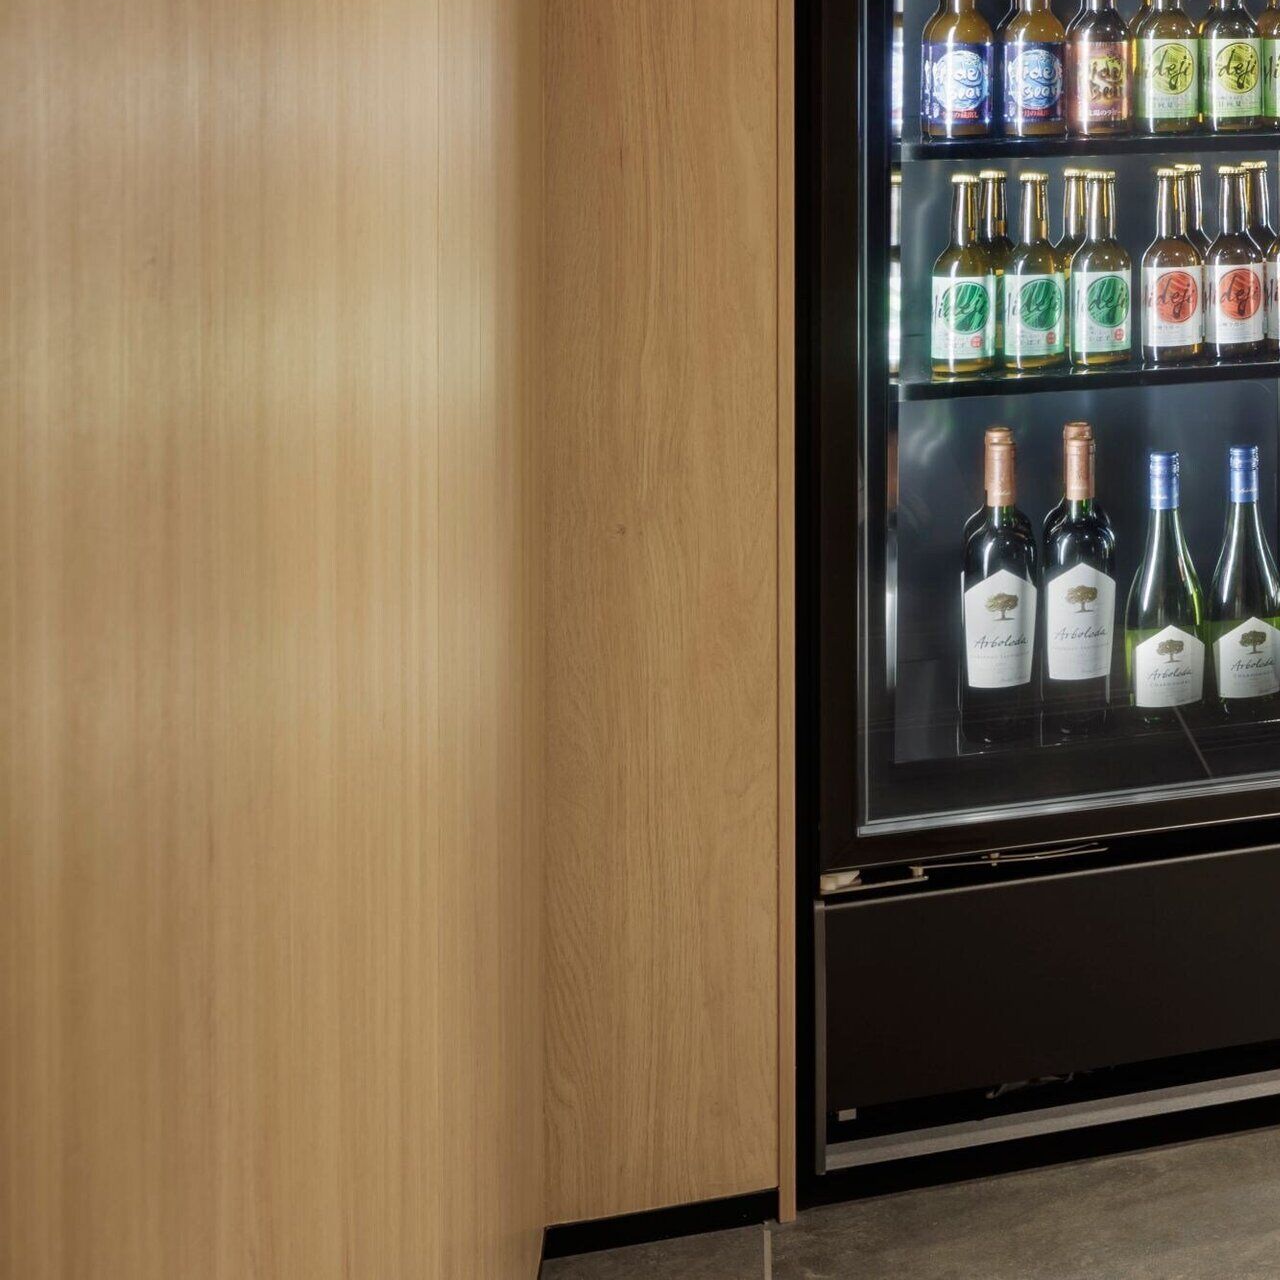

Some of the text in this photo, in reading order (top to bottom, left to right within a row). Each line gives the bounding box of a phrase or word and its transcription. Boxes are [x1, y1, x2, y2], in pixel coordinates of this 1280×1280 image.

[1053, 626, 1107, 640] Arboleda
[973, 633, 1029, 649] Arboleda
[1231, 657, 1276, 671] Arboleda
[1147, 667, 1193, 681] Arboleda
